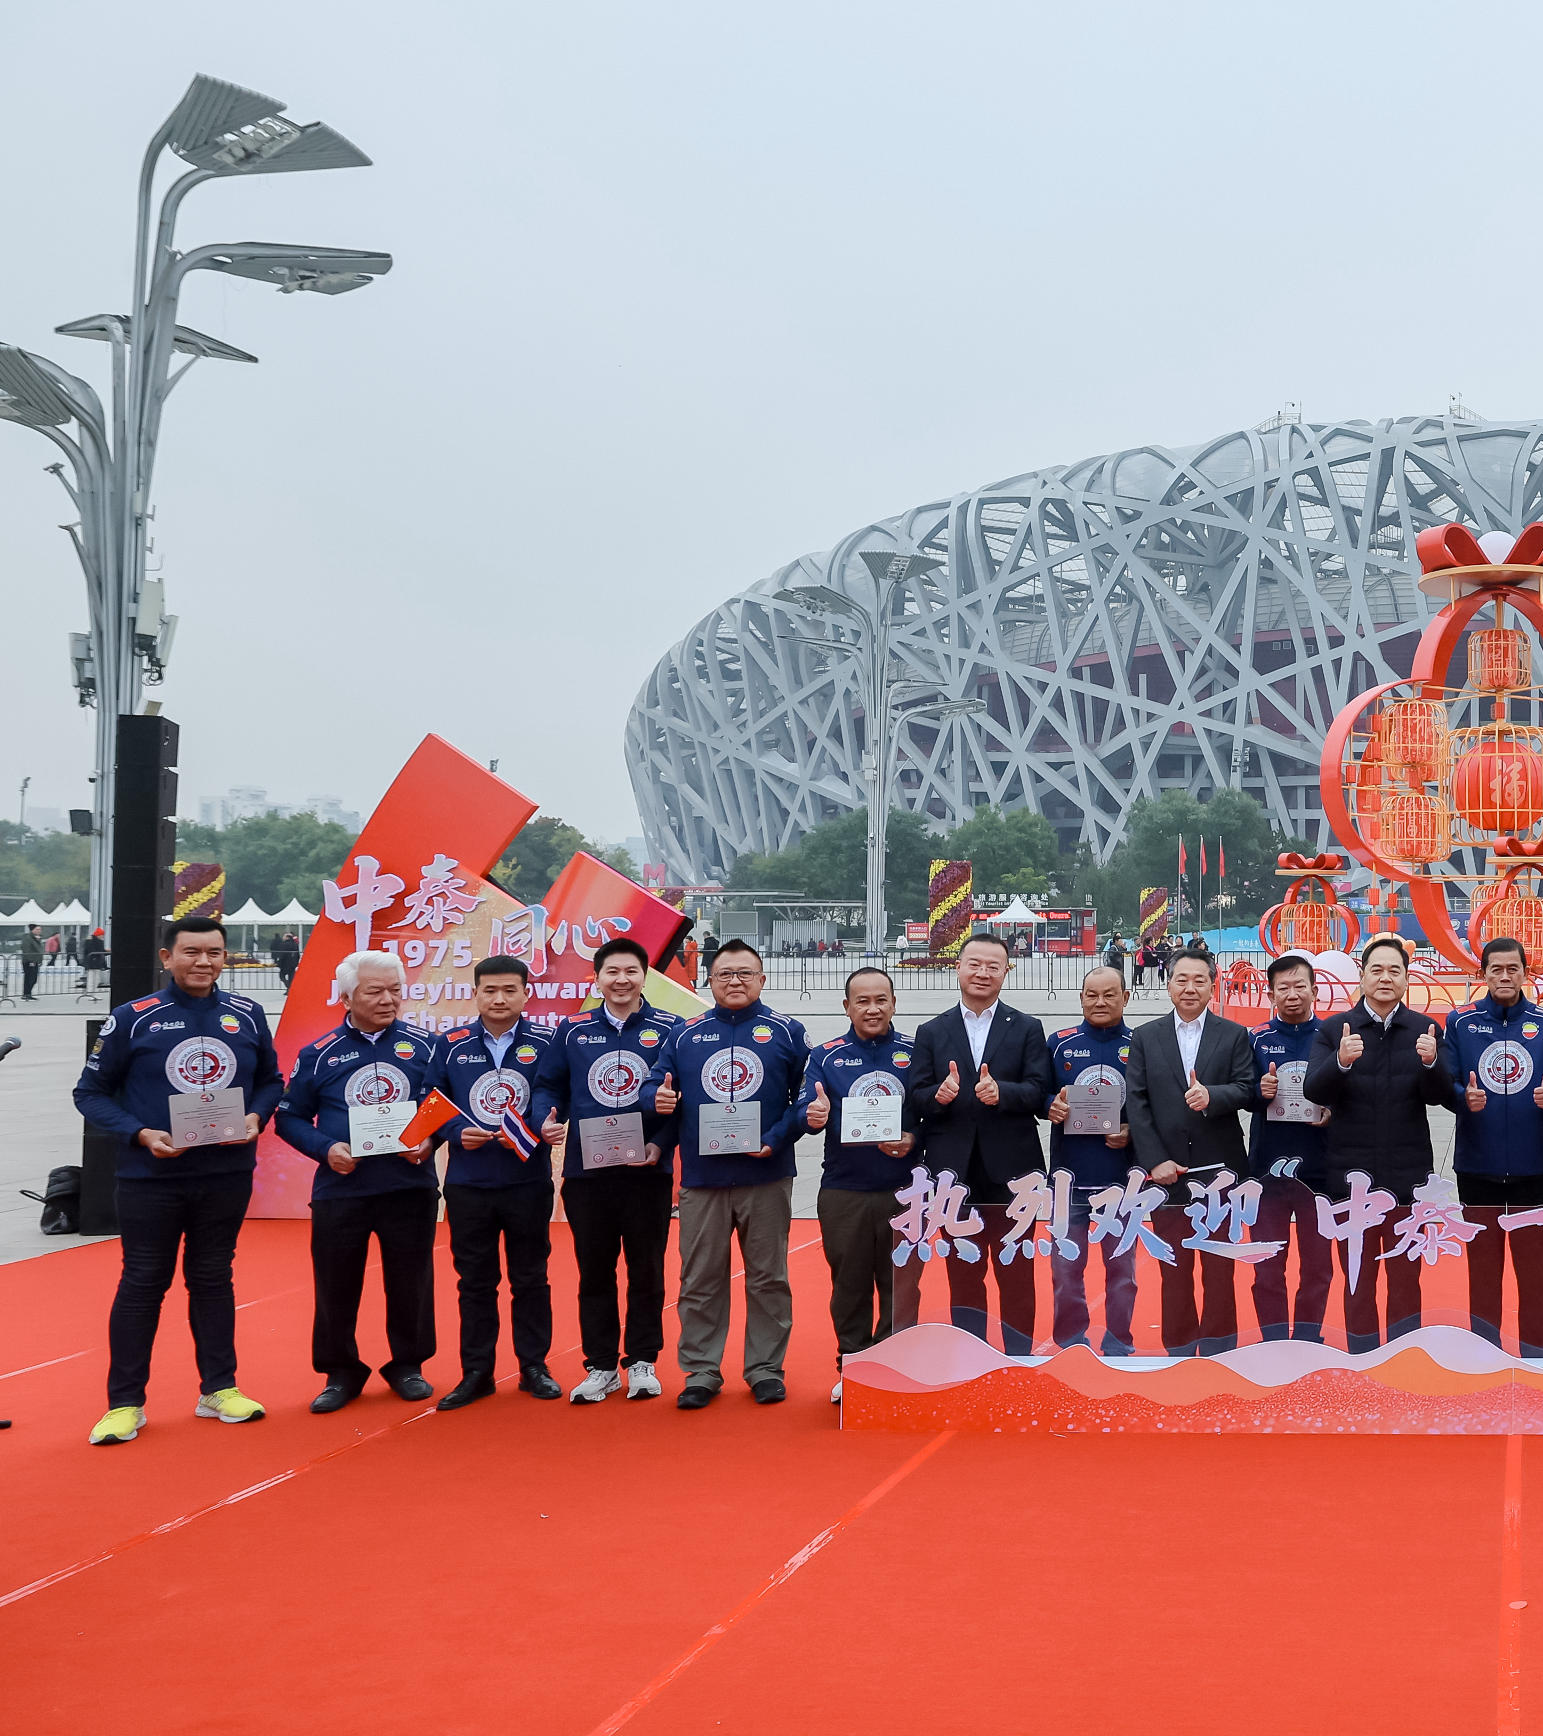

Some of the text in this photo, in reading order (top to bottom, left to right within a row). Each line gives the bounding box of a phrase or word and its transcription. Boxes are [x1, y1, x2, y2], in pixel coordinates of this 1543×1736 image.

[322, 853, 633, 978] 中泰 同心
[382, 940, 473, 968] 1975
